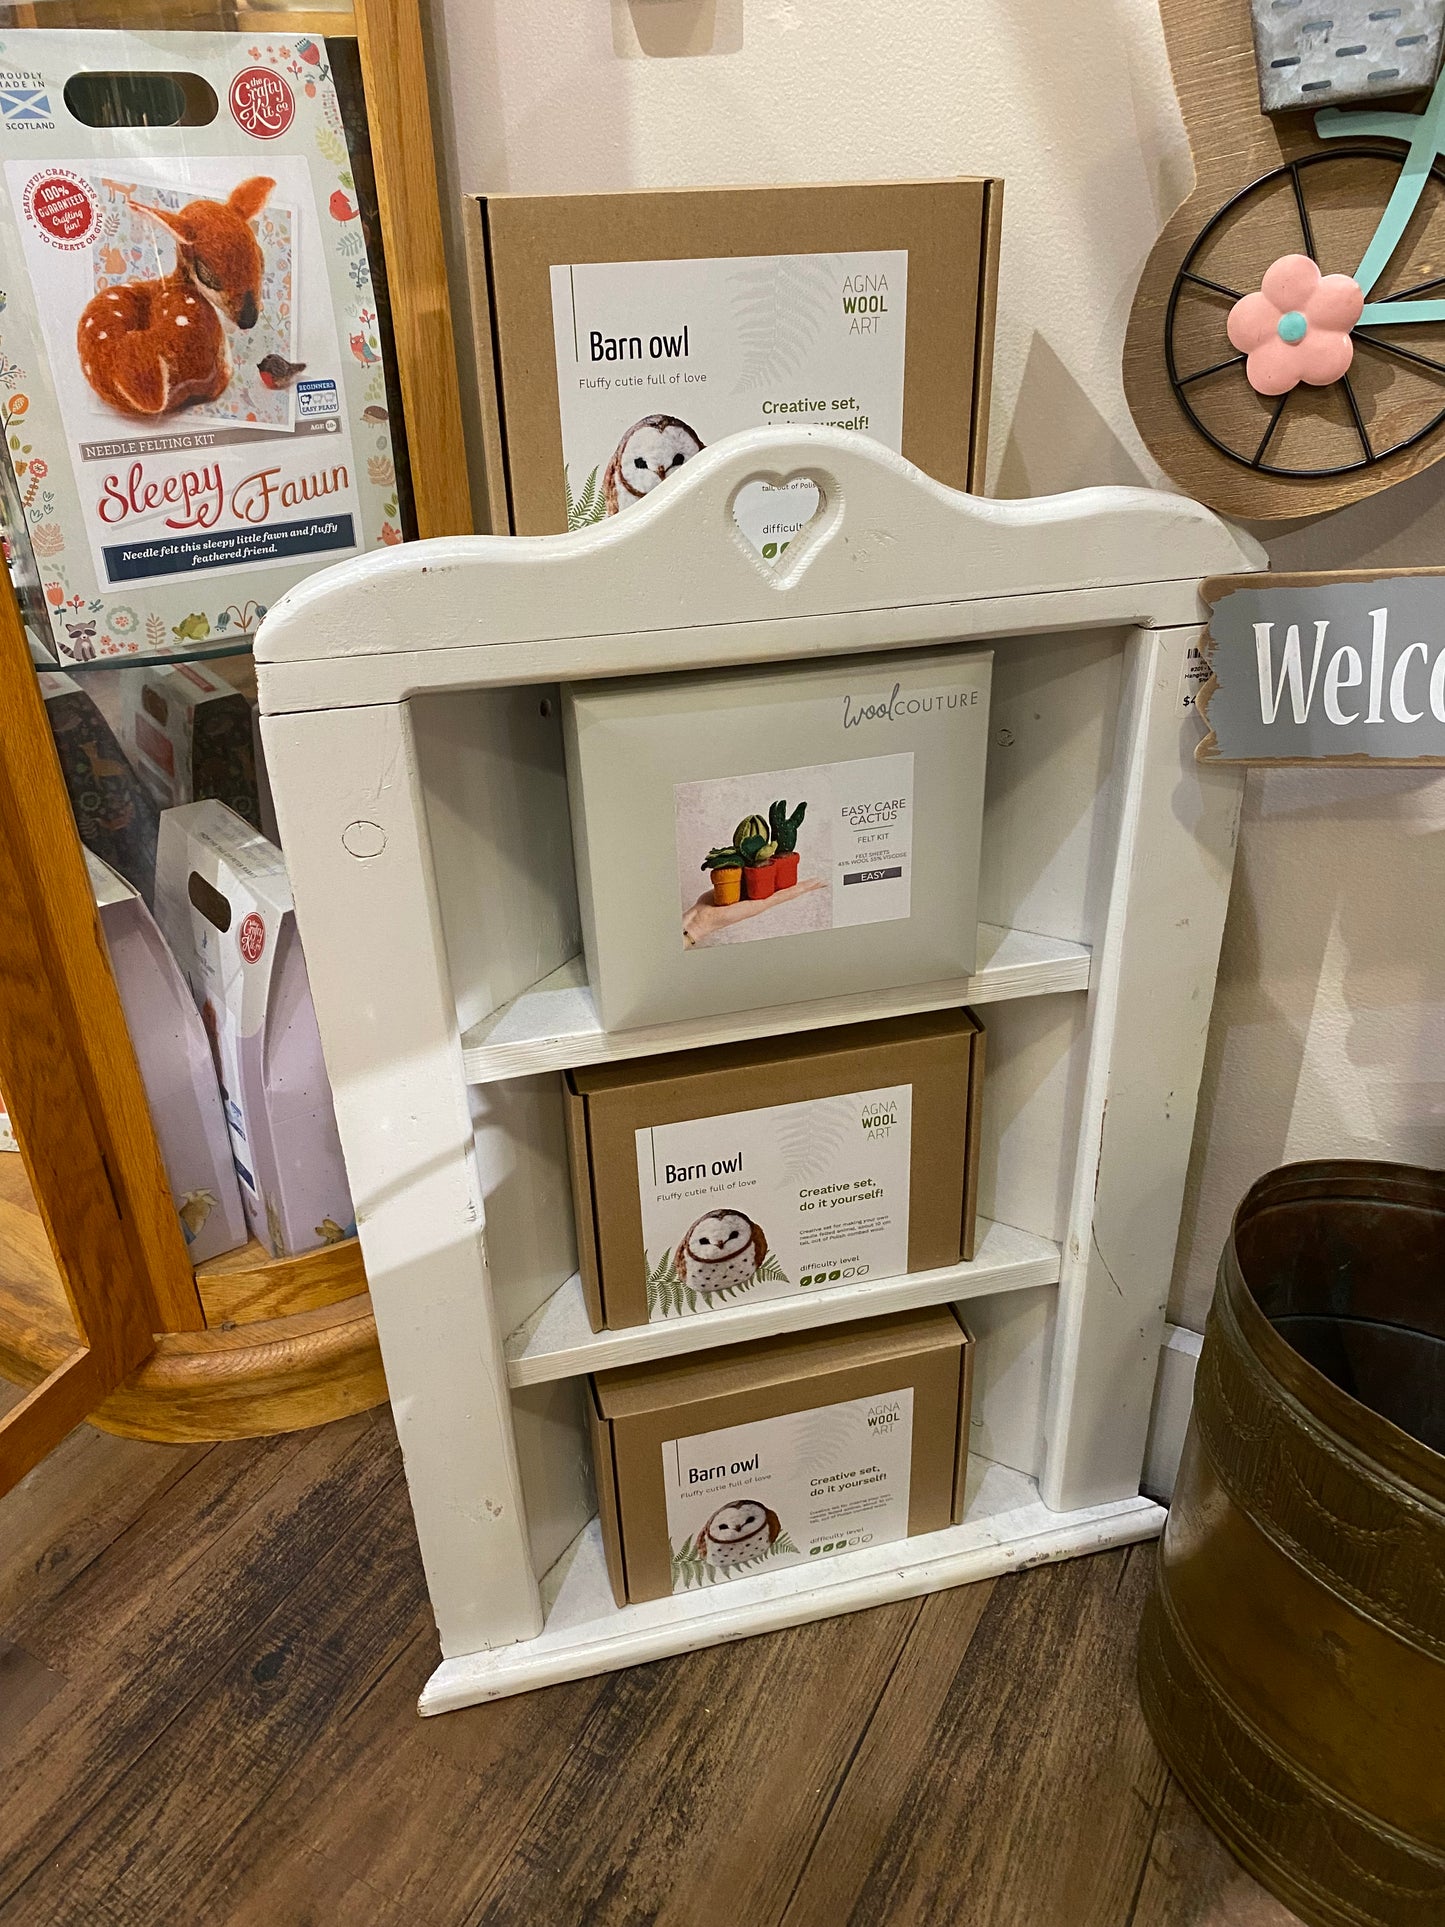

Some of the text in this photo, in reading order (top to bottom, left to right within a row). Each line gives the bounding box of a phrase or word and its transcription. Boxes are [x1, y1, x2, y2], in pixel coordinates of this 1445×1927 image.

[251, 78, 262, 87] the
[235, 78, 283, 107] Crafty
[240, 98, 282, 129] Kit
[6, 122, 55, 130] SCOTLAND
[23, 168, 97, 220] BEAUTIFUL CRAFT KITS
[41, 186, 69, 202] 100%
[38, 194, 85, 218] GUARANTEED
[52, 210, 83, 226] Crafting
[64, 219, 80, 234] fun!
[39, 212, 103, 251] TO CREATE OR GIVE
[843, 274, 889, 293] AGNA
[843, 296, 888, 314] WOOL
[849, 316, 880, 335] ART
[590, 325, 689, 361] Barn owl
[580, 372, 707, 390] Fluffy cutie full of love
[762, 396, 860, 414] Creative set,
[86, 434, 215, 457] NEEDLE FELTING KIT
[98, 462, 349, 529] Sleepy Fawn
[122, 523, 338, 561] Needle felt this sleepy little fawn and fluffy
[192, 544, 278, 566] feathered friend.
[842, 798, 906, 817] EASY CARE
[850, 810, 897, 826] CACTUS
[858, 835, 875, 843] FELT
[862, 870, 886, 882] EASY
[862, 1100, 898, 1117] AGNA
[862, 1114, 897, 1129] WOOL
[867, 1127, 891, 1141] ART
[666, 1152, 742, 1184] Barn owl
[657, 1180, 757, 1202] Fluffy cutie full of love
[800, 1178, 876, 1198] Creative set,
[800, 1189, 884, 1211] do it yourself!
[800, 1256, 860, 1272] difficulty level
[868, 1402, 900, 1417] AGNA
[868, 1413, 900, 1426] WOOL
[872, 1424, 894, 1436] ART
[689, 1454, 759, 1484] Barn owl
[810, 1472, 856, 1486] Creative
[810, 1489, 824, 1497] do
[838, 1474, 887, 1492] yourself!
[681, 1490, 703, 1499] Fluffy
[706, 1485, 726, 1493] cutie
[729, 1481, 742, 1489] full
[810, 1532, 844, 1544] difficulty
